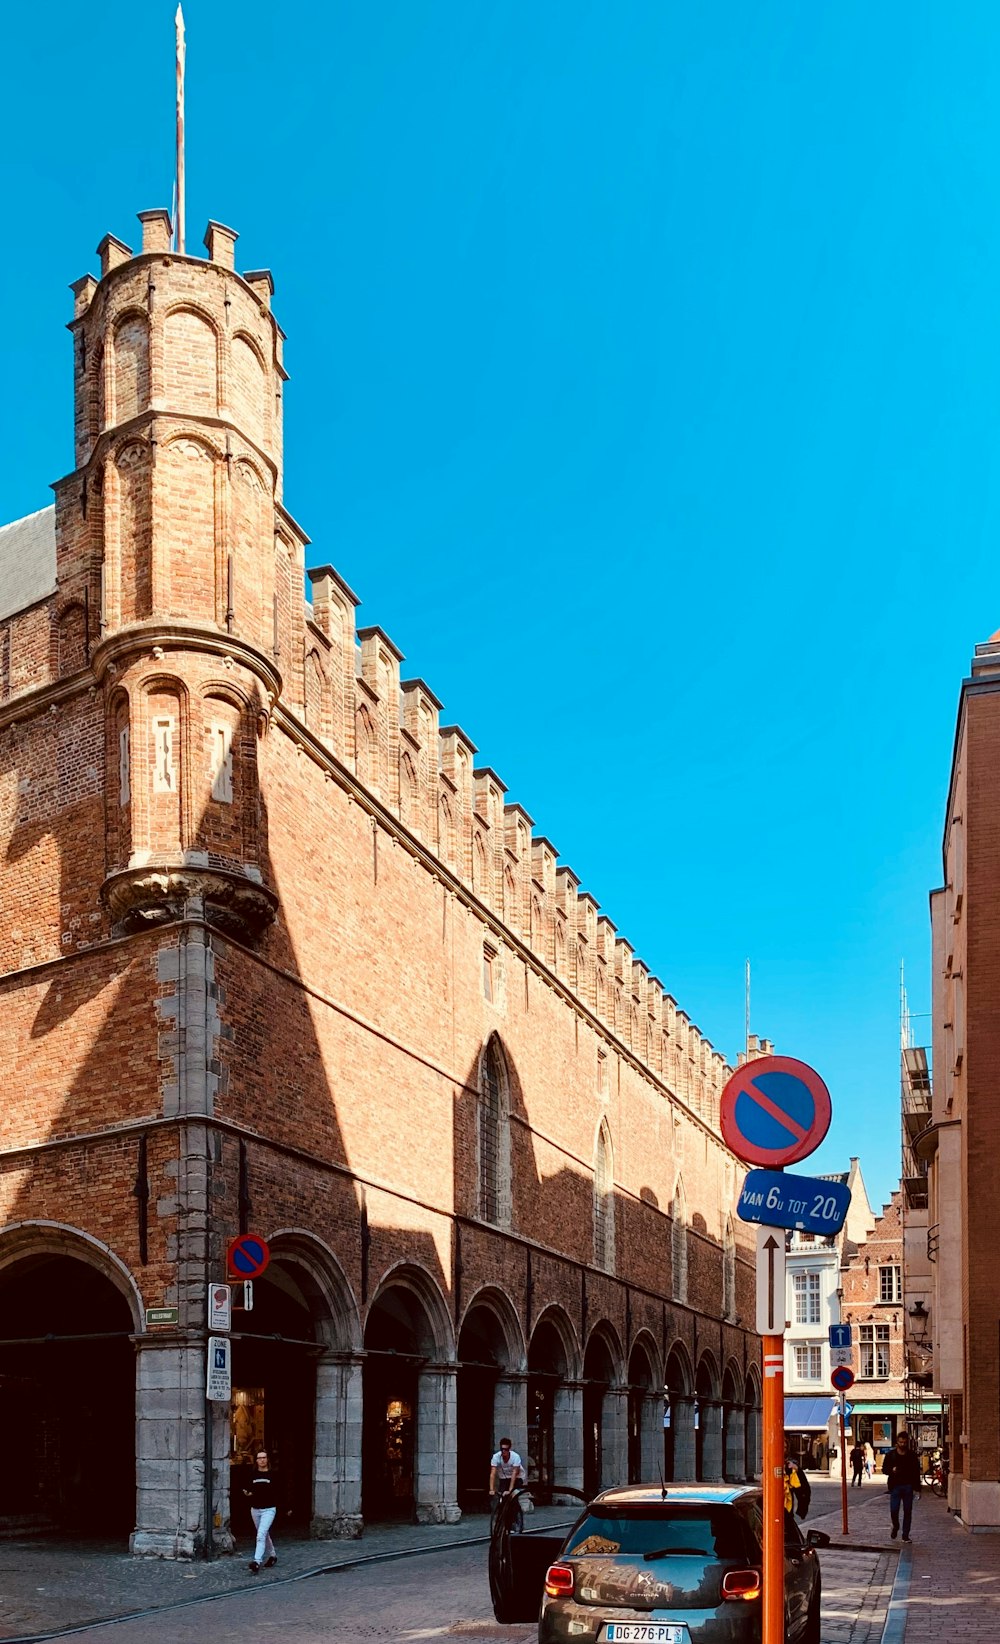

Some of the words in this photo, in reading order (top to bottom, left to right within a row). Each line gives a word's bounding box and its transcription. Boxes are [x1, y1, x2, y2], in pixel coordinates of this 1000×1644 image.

[743, 1191, 764, 1206] VAN
[788, 1199, 808, 1215] TOT
[214, 1339, 227, 1348] ZONE
